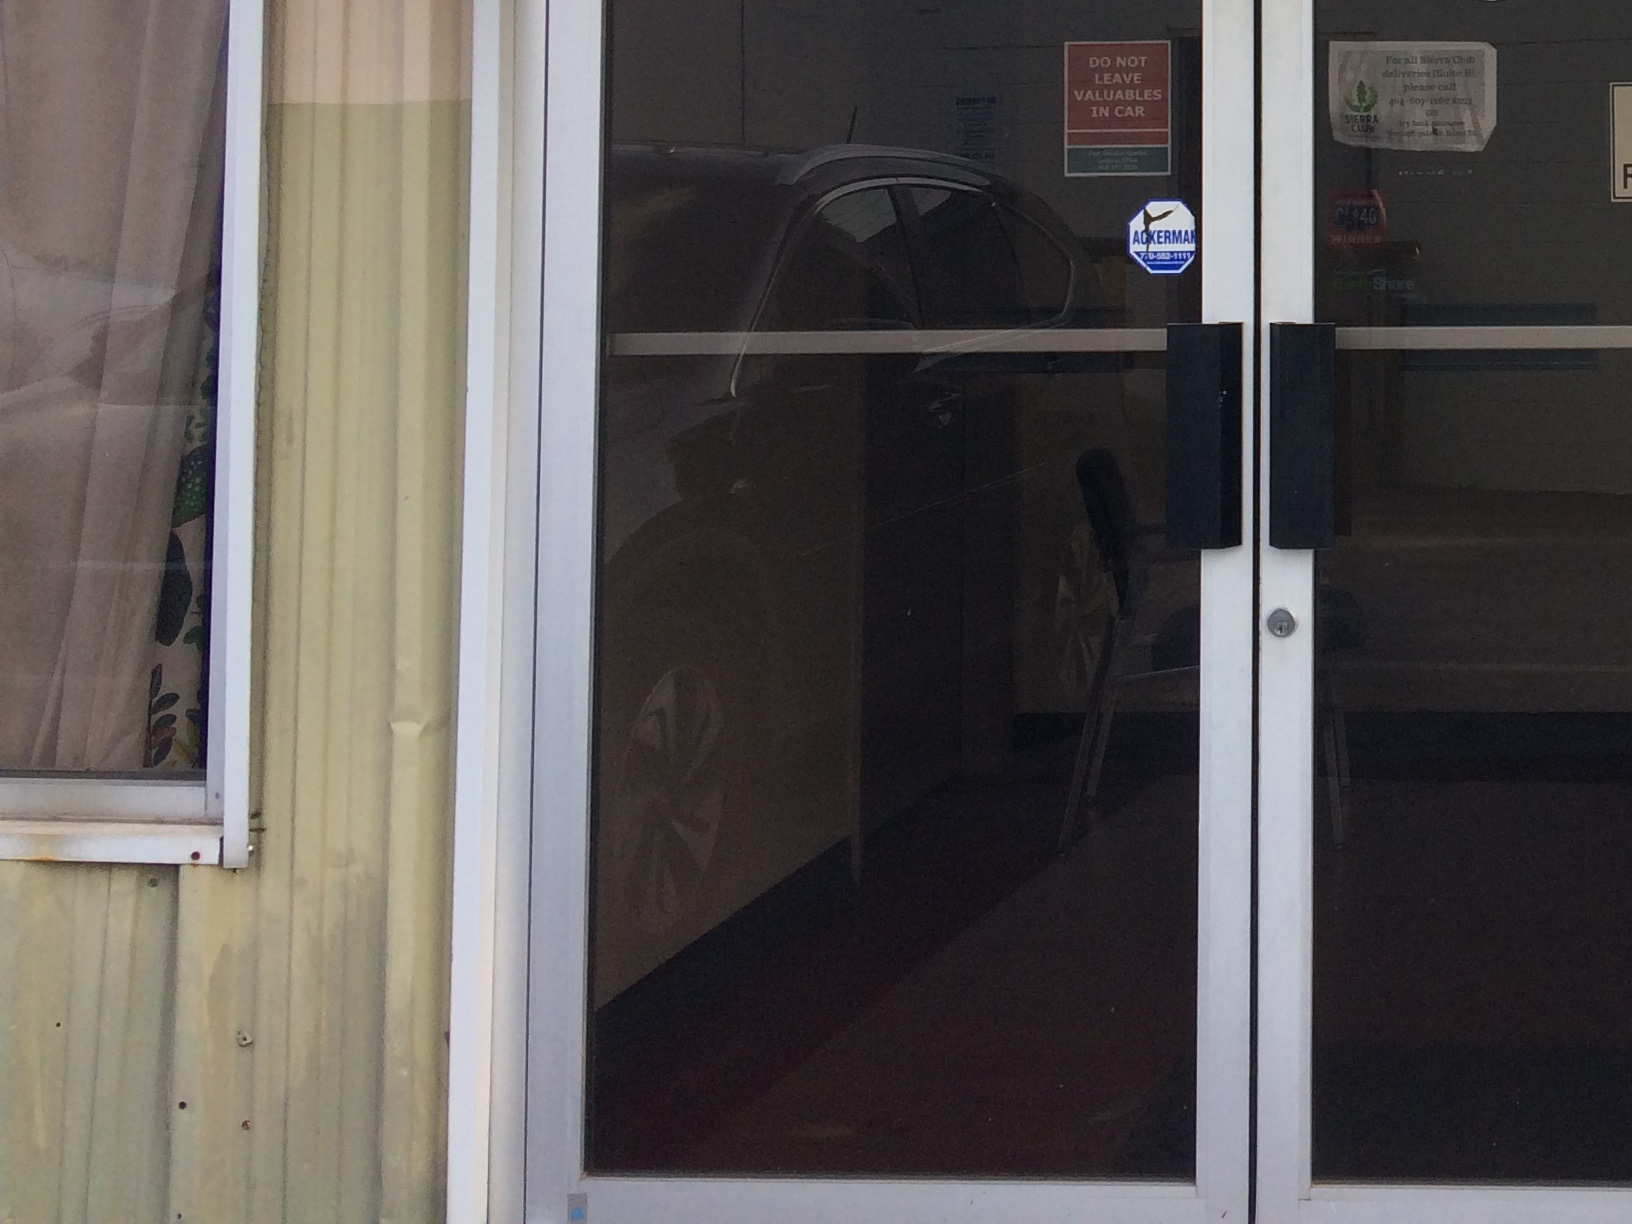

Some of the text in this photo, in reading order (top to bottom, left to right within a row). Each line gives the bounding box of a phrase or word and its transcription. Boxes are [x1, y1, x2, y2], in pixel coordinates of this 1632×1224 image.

[1089, 56, 1148, 68] DO NOT
[1385, 55, 1402, 64] For
[1420, 55, 1450, 64] Sierra
[1452, 55, 1475, 64] Club
[1094, 72, 1142, 84] LEAVE
[1403, 83, 1456, 94] please call
[1074, 89, 1163, 101] VALUABLES
[1090, 106, 1145, 117] IN CAR
[1344, 114, 1379, 124] SIERRA
[1350, 124, 1375, 133] CLUB
[1132, 229, 1197, 245] ACKERMAN
